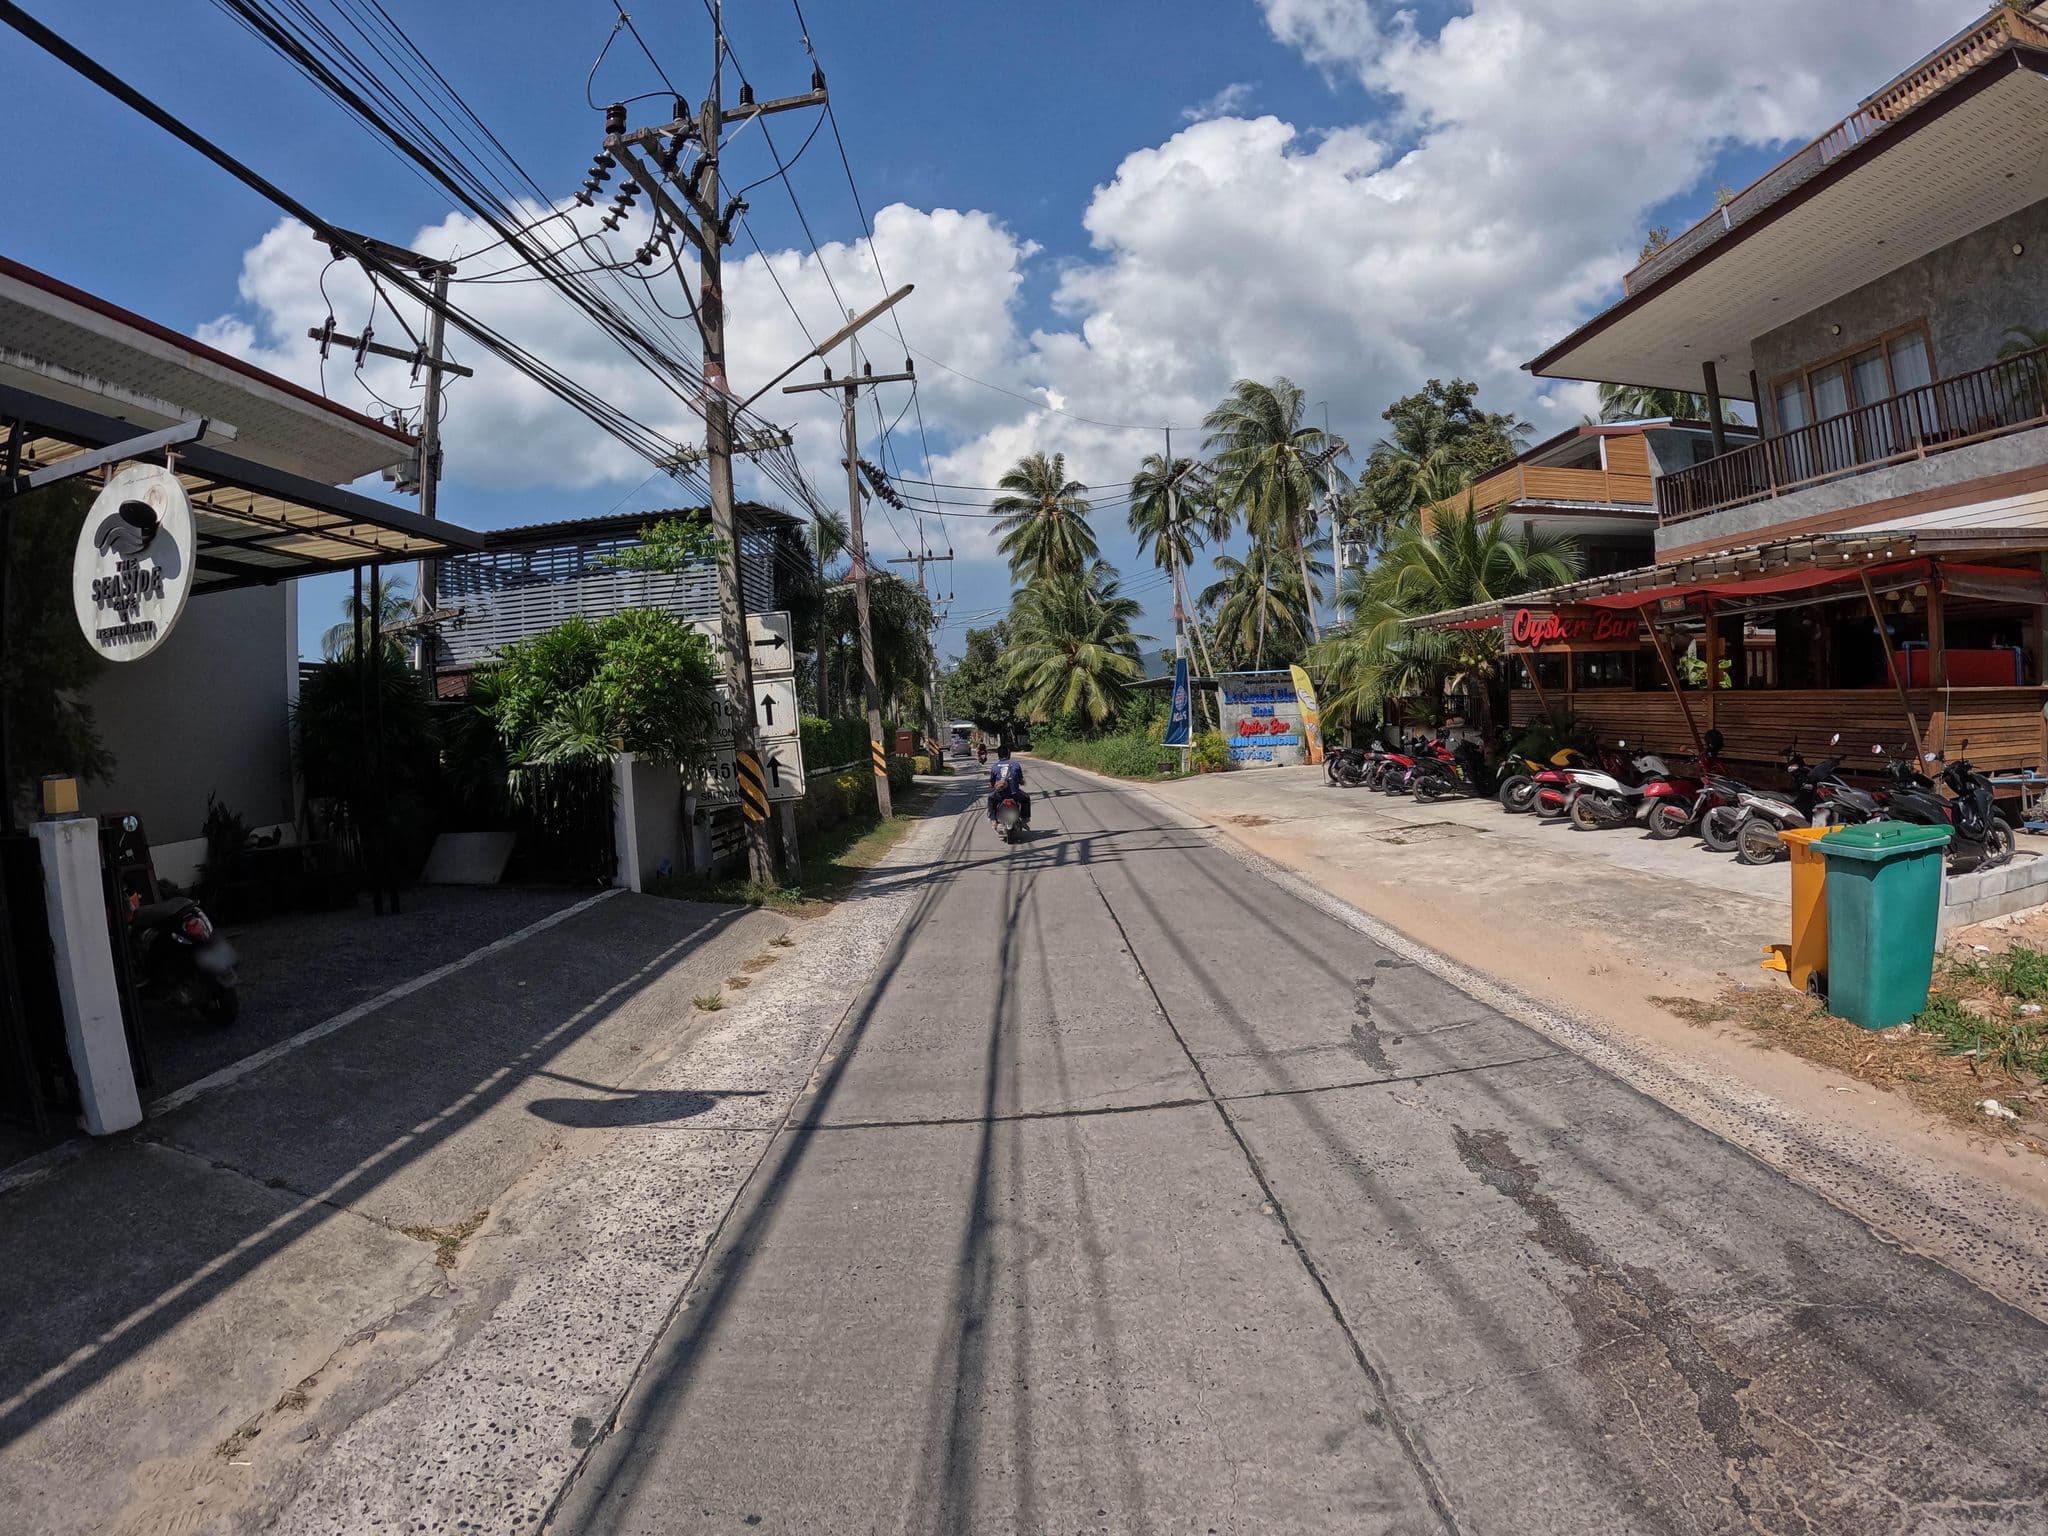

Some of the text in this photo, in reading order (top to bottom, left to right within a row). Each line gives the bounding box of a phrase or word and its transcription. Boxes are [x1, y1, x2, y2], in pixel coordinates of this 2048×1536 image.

[115, 559, 140, 573] THE
[91, 566, 163, 602] SEASIDE
[1512, 607, 1639, 648] Oyster Bar
[1238, 716, 1291, 737] Oyster Bar
[1249, 734, 1298, 748] PHANGAN
[1229, 748, 1273, 762] Diving
